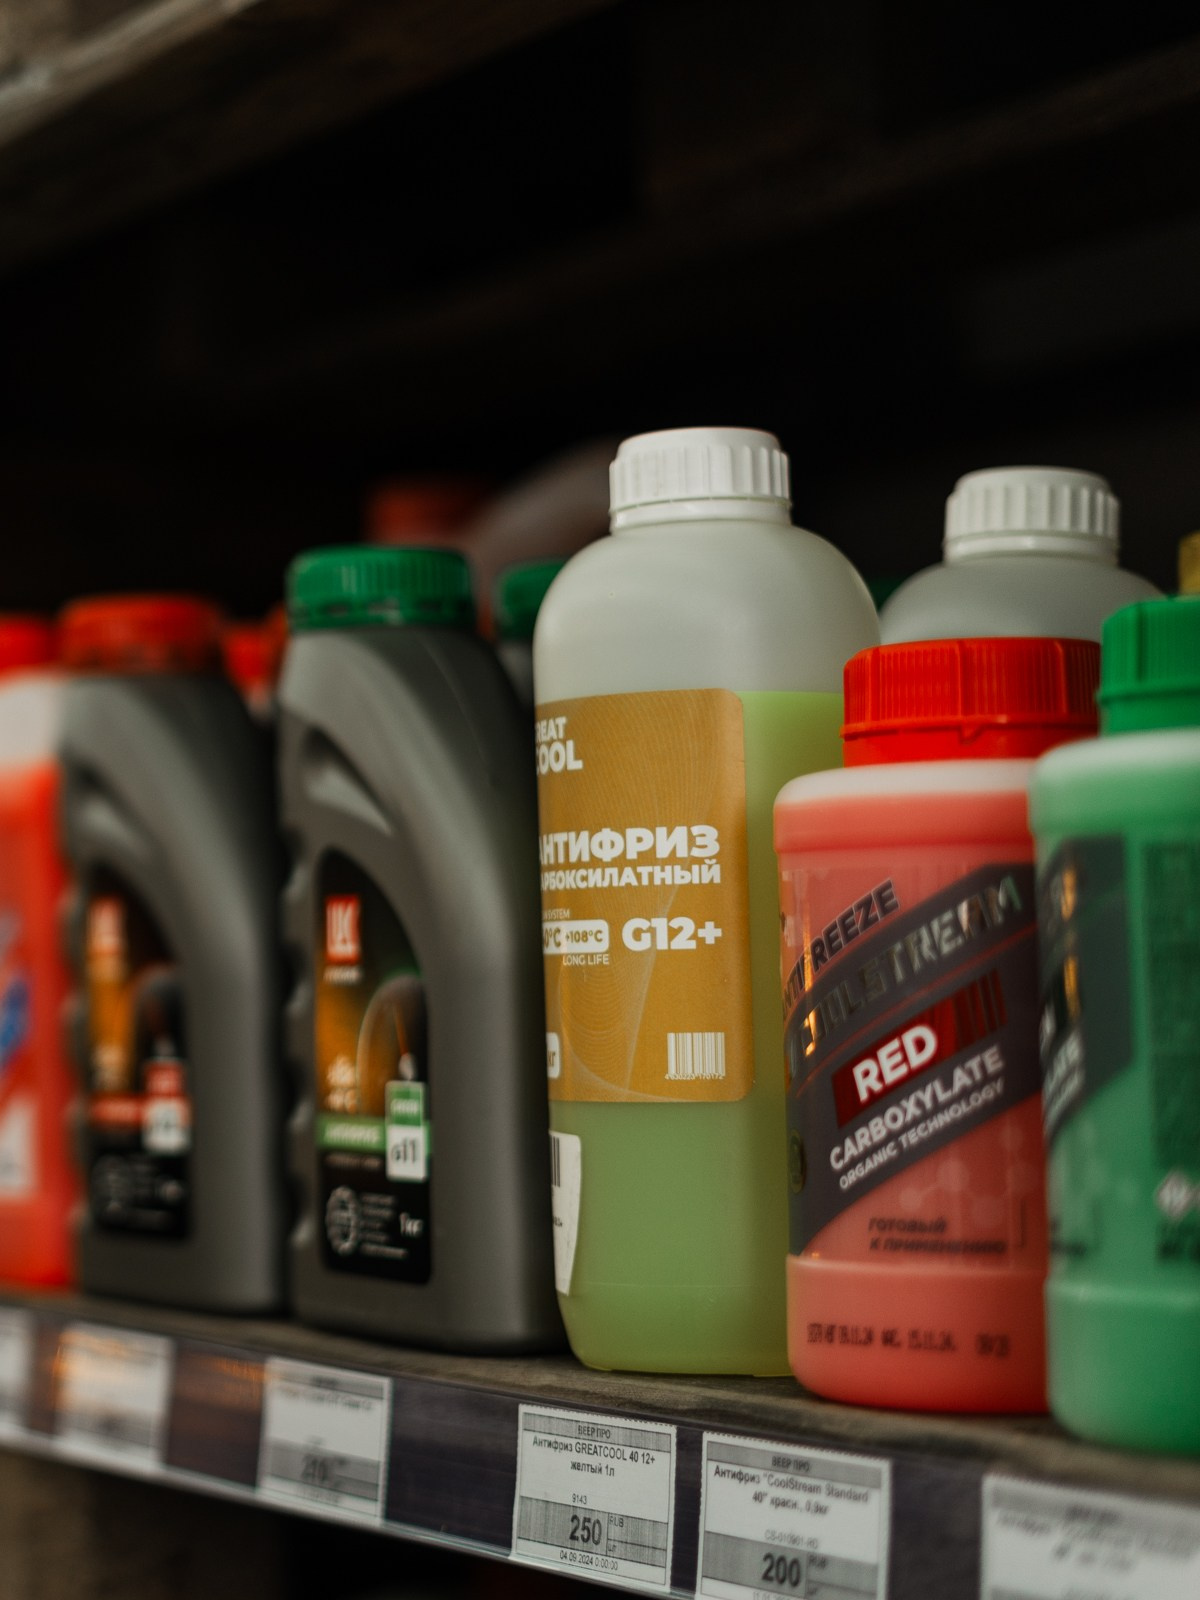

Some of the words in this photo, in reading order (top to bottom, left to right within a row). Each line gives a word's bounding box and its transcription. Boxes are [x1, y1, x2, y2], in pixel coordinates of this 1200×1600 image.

[540, 859, 721, 891] АРБОКСИЛАТНЫЙ
[565, 929, 603, 943] +108°C
[622, 917, 722, 951] G12+
[563, 954, 586, 967] LONG
[588, 953, 610, 965] LIFE
[852, 1025, 937, 1103] RED
[830, 1045, 1005, 1171] CARBOXYLATE
[839, 1141, 897, 1191] ORGANIC
[899, 1077, 1005, 1148] TECHNOLOGY
[533, 1435, 573, 1453] Антифриз
[574, 1442, 627, 1461] GREATCOOL
[629, 1450, 639, 1463] 40
[641, 1452, 655, 1464] 12+
[570, 1460, 602, 1474] желтый
[605, 1464, 615, 1477] 1л
[714, 1464, 761, 1485] Антифриз
[825, 1482, 869, 1504] Standard
[572, 1493, 587, 1505] 9143
[569, 1514, 602, 1546] 250
[762, 1552, 801, 1588] 200
